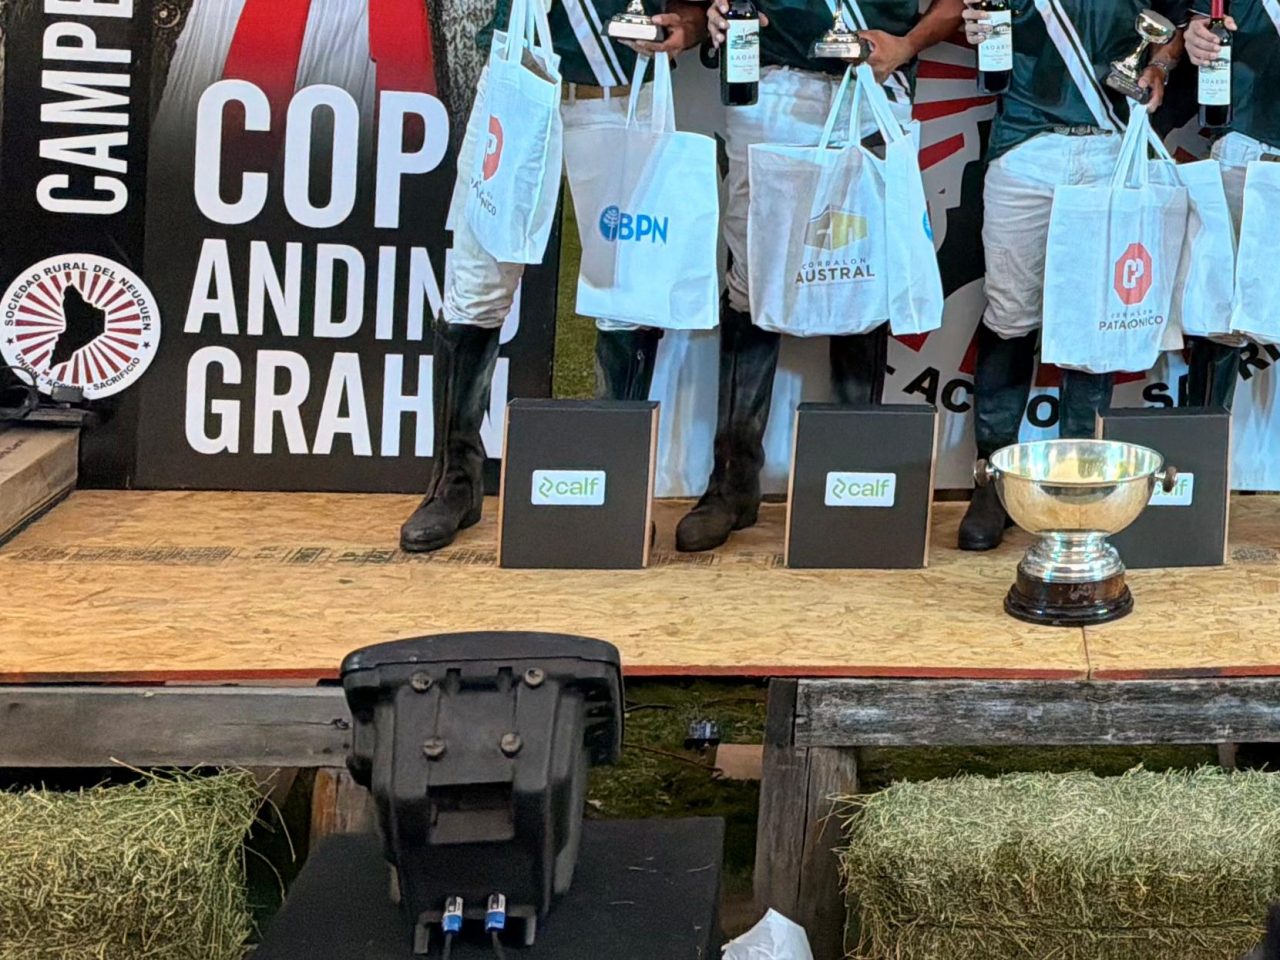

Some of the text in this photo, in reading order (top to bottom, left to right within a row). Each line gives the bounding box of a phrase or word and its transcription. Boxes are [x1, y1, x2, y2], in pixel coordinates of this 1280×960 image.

[193, 80, 456, 231] COP
[618, 212, 669, 245] BPN
[184, 237, 521, 344] ANDIN
[795, 264, 875, 285] AUSTRAL
[4, 262, 152, 331] SOCIEDAD RURAL DEL NEUQUEN
[93, 357, 141, 390] SACRIFICIO
[555, 476, 599, 497] calf
[847, 477, 890, 498] calf
